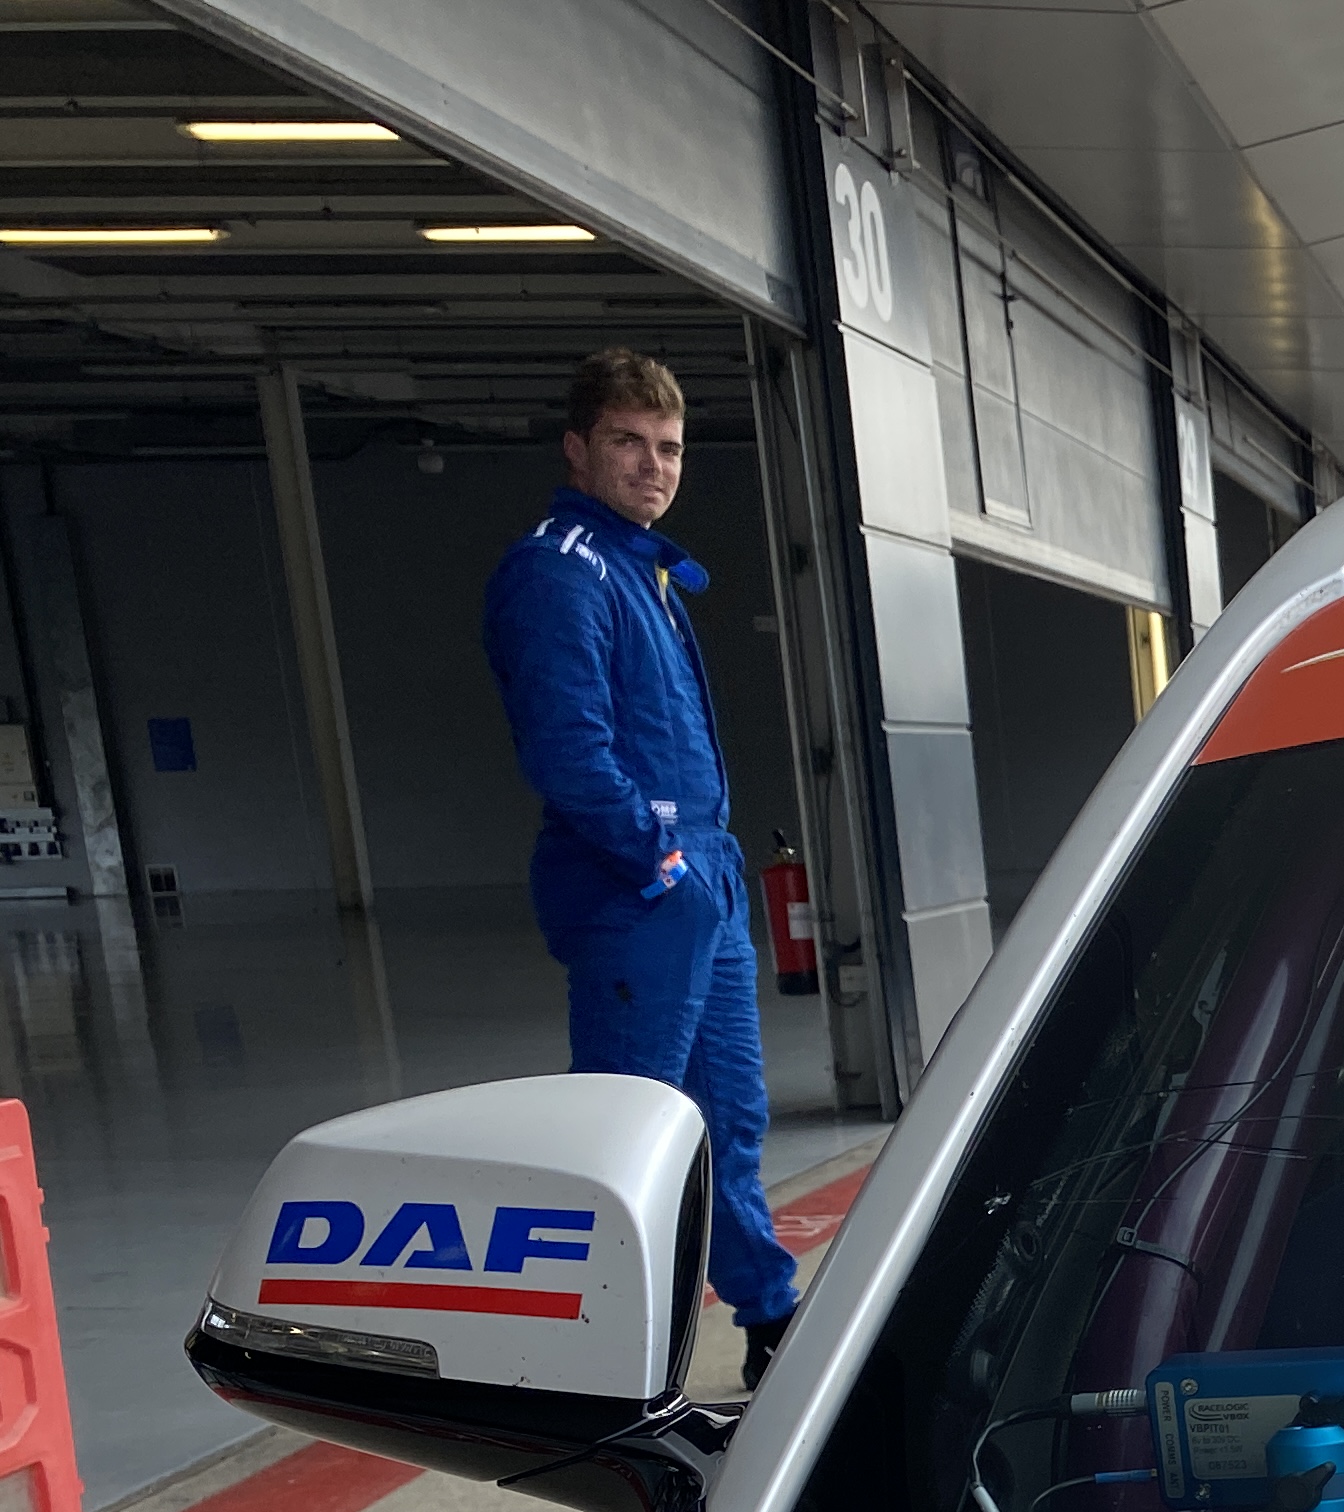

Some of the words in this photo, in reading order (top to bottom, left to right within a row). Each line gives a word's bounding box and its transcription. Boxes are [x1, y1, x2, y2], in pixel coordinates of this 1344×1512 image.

[834, 163, 892, 322] 30
[265, 1200, 595, 1274] DAF
[1162, 1391, 1171, 1421] POWER
[1197, 1403, 1249, 1412] RACELOGIC
[1189, 1423, 1230, 1433] VBPIT01
[1165, 1433, 1176, 1465] COMMS
[1170, 1472, 1179, 1489] ANT
